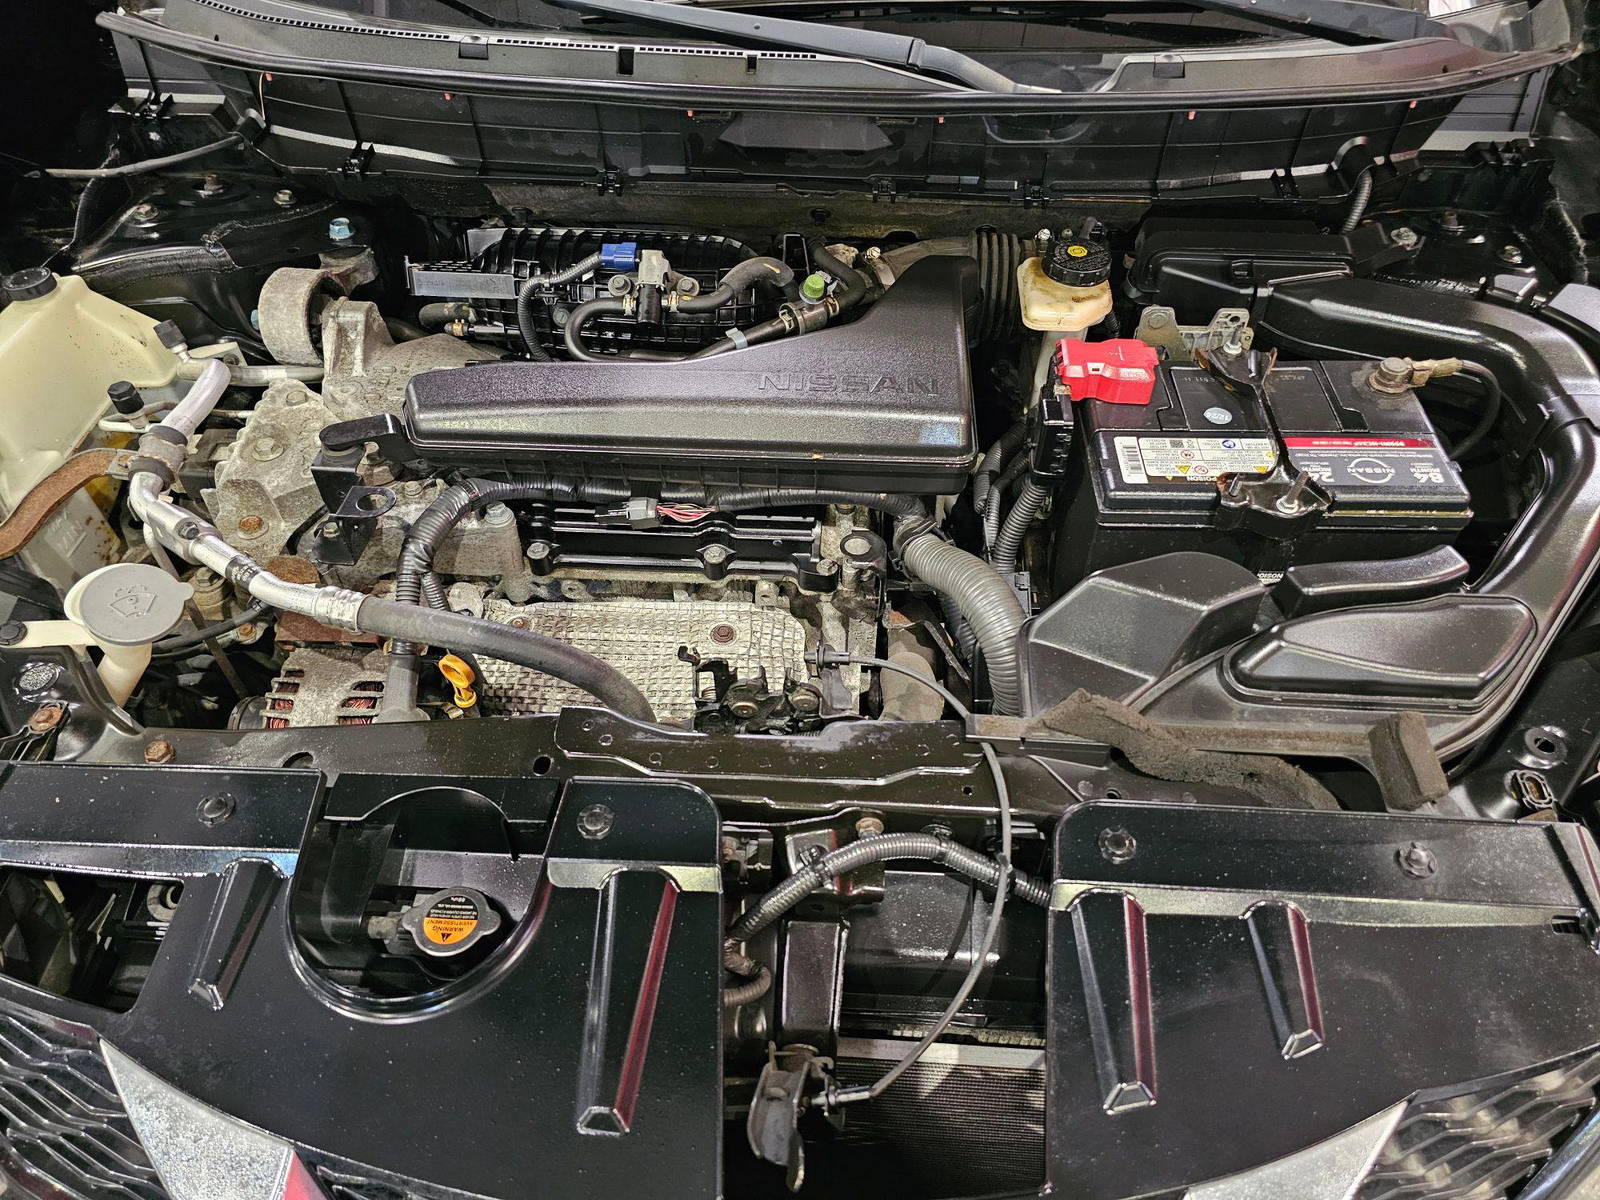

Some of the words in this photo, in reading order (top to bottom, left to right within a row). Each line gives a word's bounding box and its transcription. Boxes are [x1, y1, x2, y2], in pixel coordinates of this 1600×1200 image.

[757, 374, 939, 397] NISSAN
[1347, 466, 1396, 474] NISSAN
[1413, 472, 1445, 484] 84
